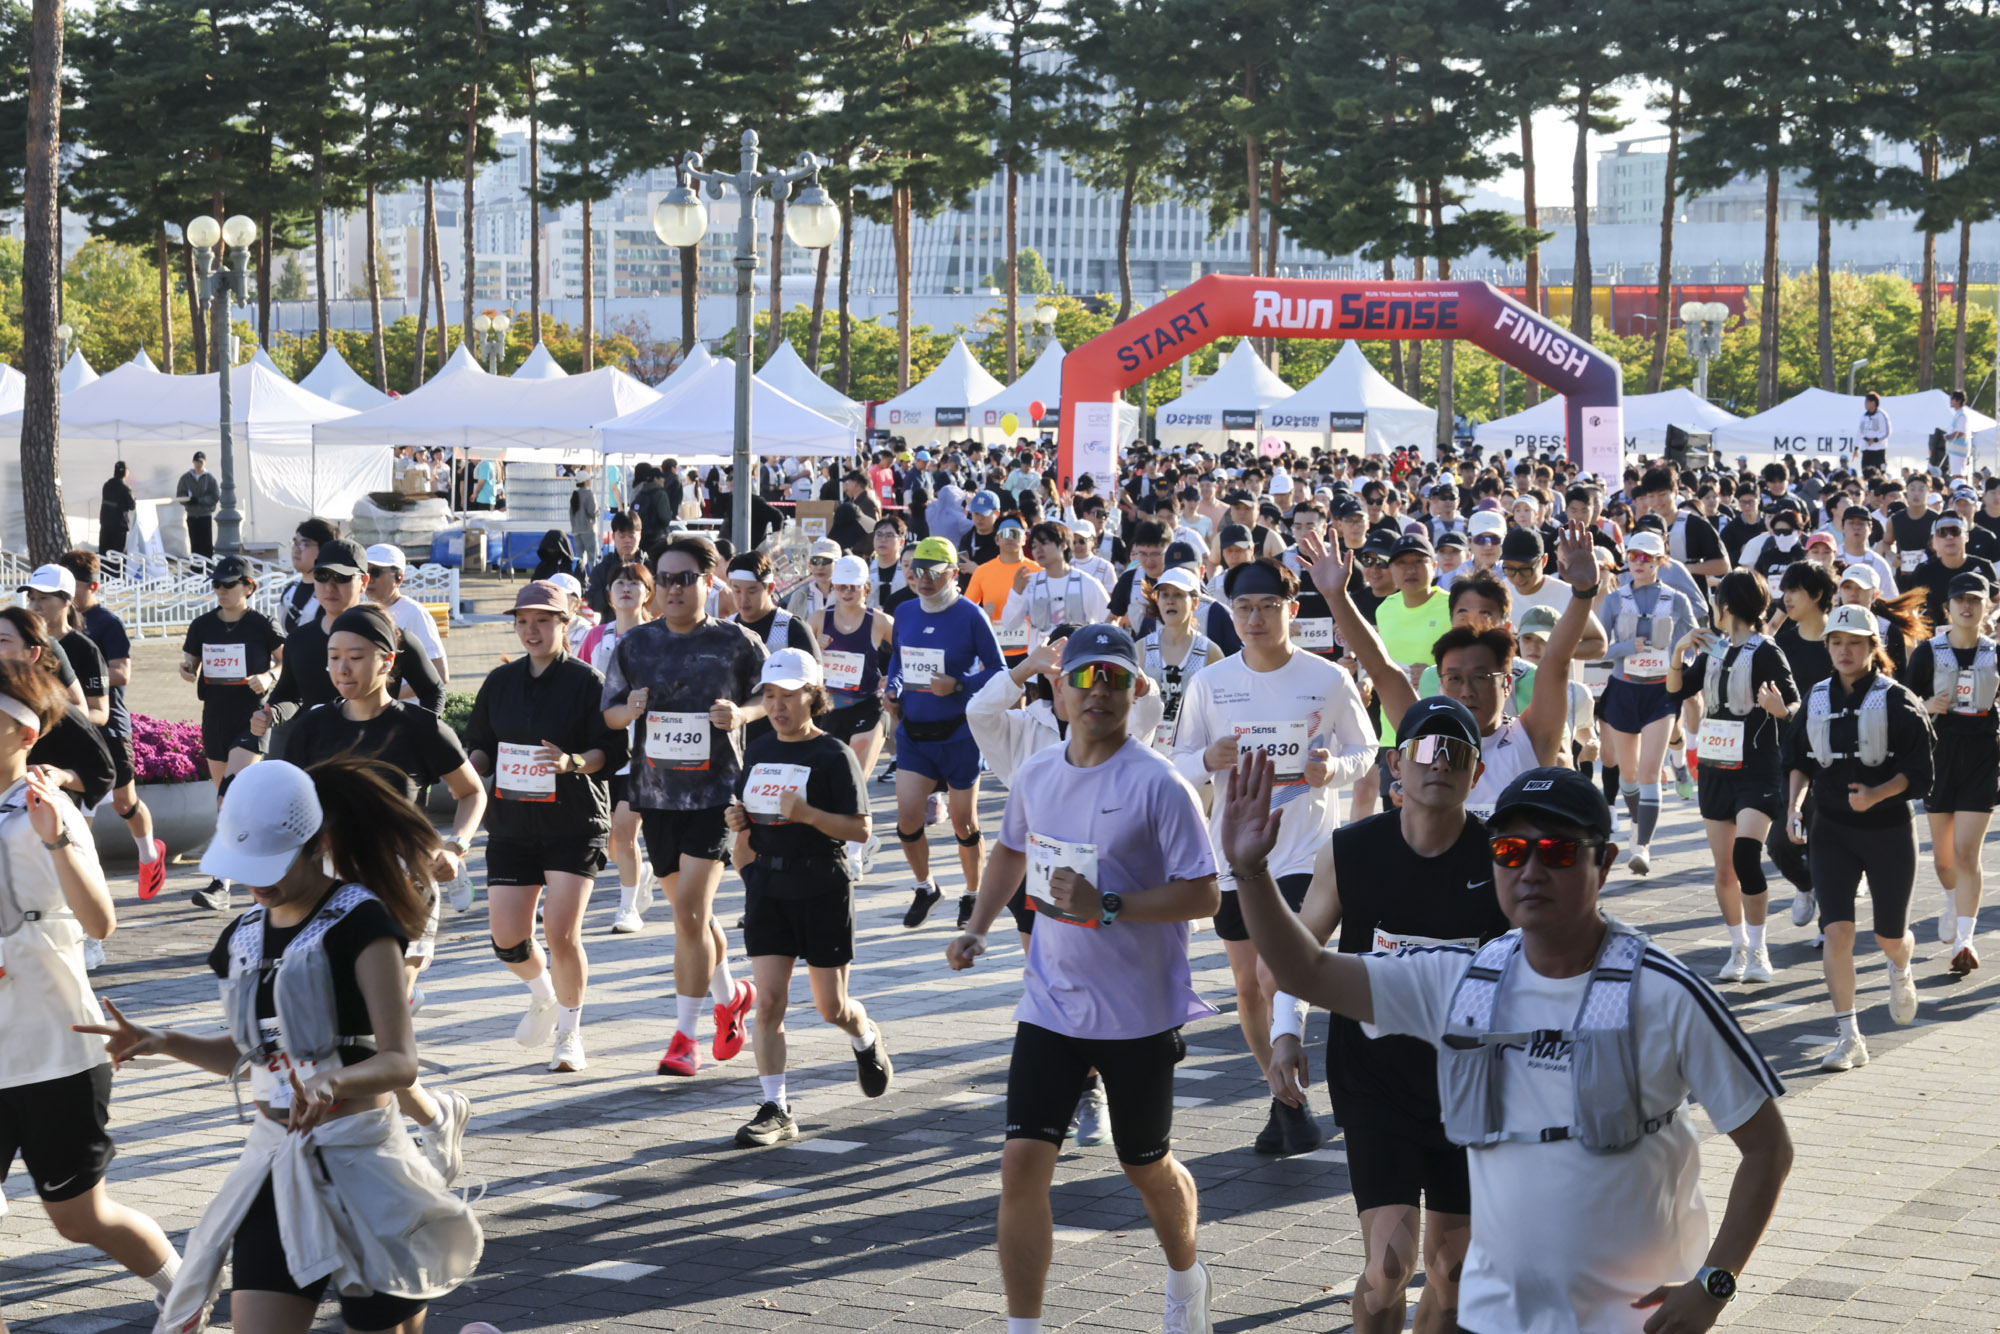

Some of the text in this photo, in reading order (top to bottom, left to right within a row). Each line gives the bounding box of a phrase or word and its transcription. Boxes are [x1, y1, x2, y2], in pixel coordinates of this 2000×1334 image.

[552, 257, 560, 279] 12
[1117, 302, 1209, 372] START
[1493, 306, 1590, 378] FINISH
[1774, 436, 1806, 452] MC
[1303, 629, 1328, 638] 1655
[213, 658, 239, 667] 2571
[912, 662, 938, 673] 1093
[1638, 658, 1664, 668] 2551
[653, 732, 702, 744] M 1430
[1708, 736, 1735, 748] 2011
[501, 763, 548, 777] W 2109
[751, 785, 760, 794] W
[1525, 780, 1551, 790] NIKE
